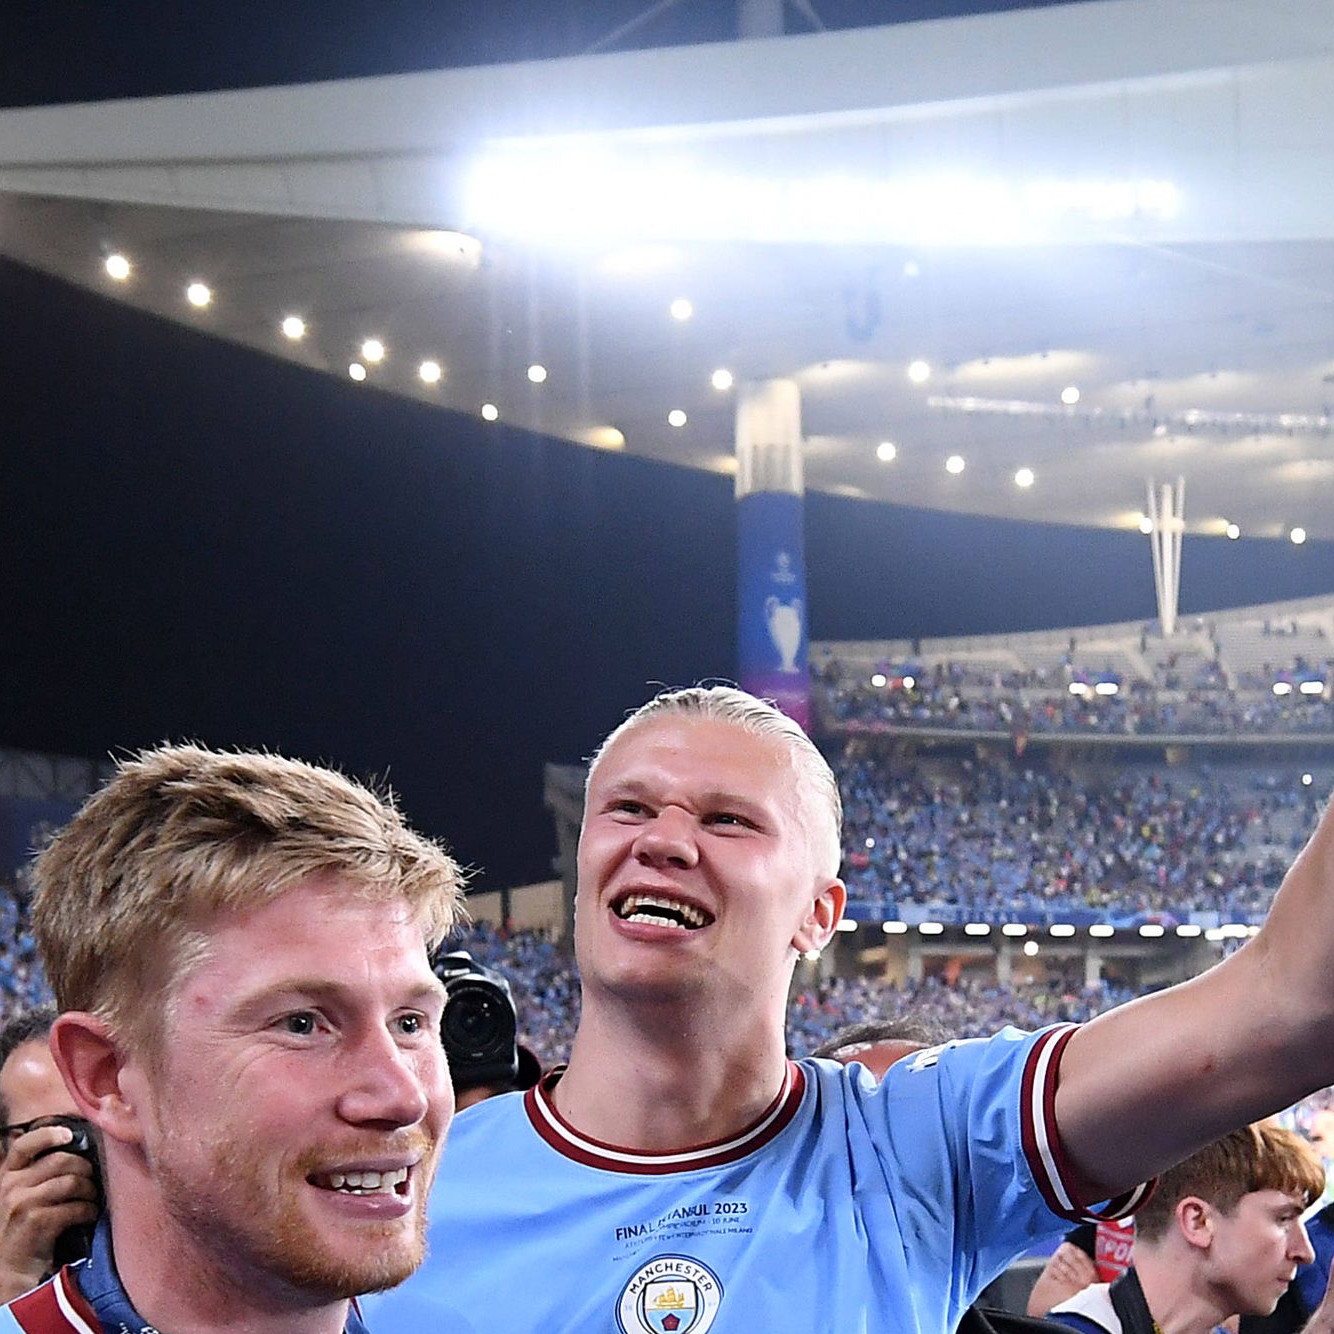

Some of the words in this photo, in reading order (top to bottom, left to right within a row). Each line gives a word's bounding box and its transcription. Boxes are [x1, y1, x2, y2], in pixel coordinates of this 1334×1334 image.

[615, 1223, 655, 1241] FINAL
[715, 1202, 748, 1215] 2023
[629, 1262, 714, 1296] MANCHESTER
